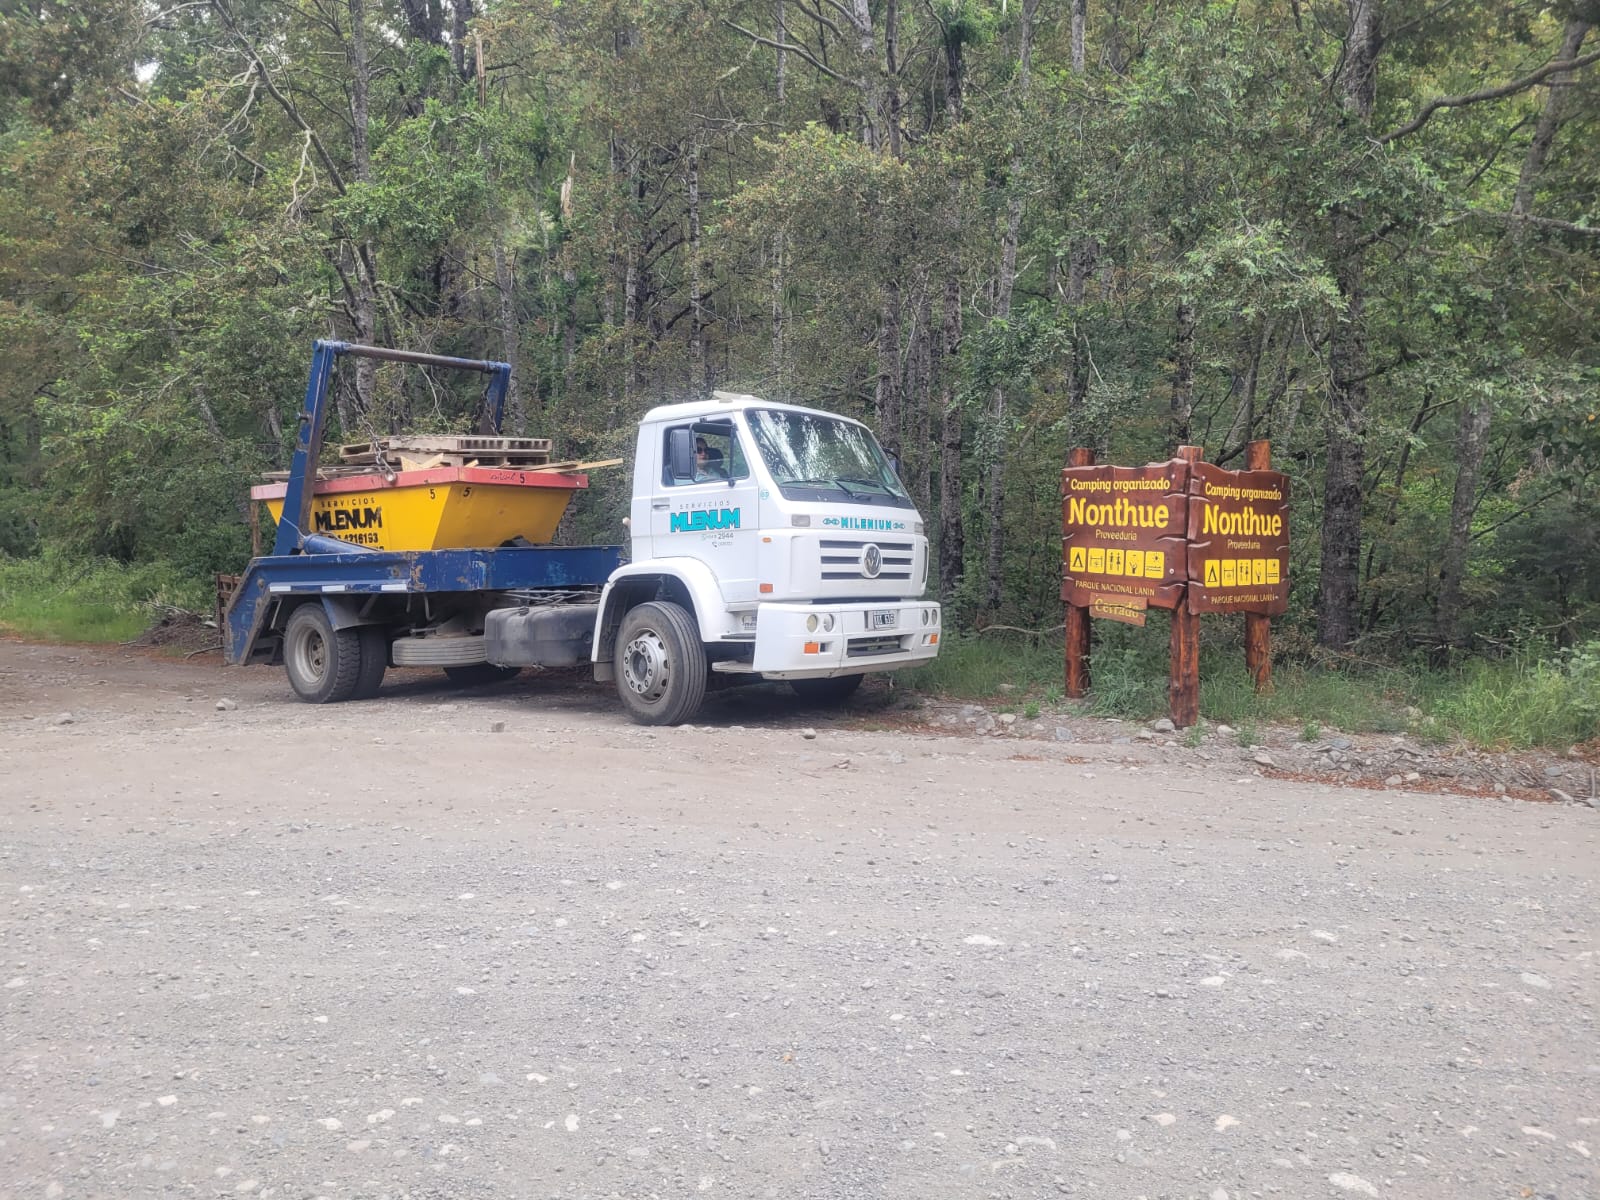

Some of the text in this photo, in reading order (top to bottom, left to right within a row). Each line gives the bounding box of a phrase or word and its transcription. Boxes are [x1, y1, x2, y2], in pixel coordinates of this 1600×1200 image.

[520, 473, 526, 484] 5
[1071, 477, 1171, 493] Camping organizado
[430, 489, 435, 499] 5
[463, 487, 471, 497] 5
[1205, 482, 1282, 502] Camping organizado
[321, 497, 375, 508] SERVICIOS
[1068, 497, 1170, 528] Nonthue
[1203, 503, 1282, 537] Nonthue
[1075, 580, 1099, 590] PARQUE
[1100, 583, 1133, 594] NACIONAL
[1211, 595, 1233, 605] PARQUE
